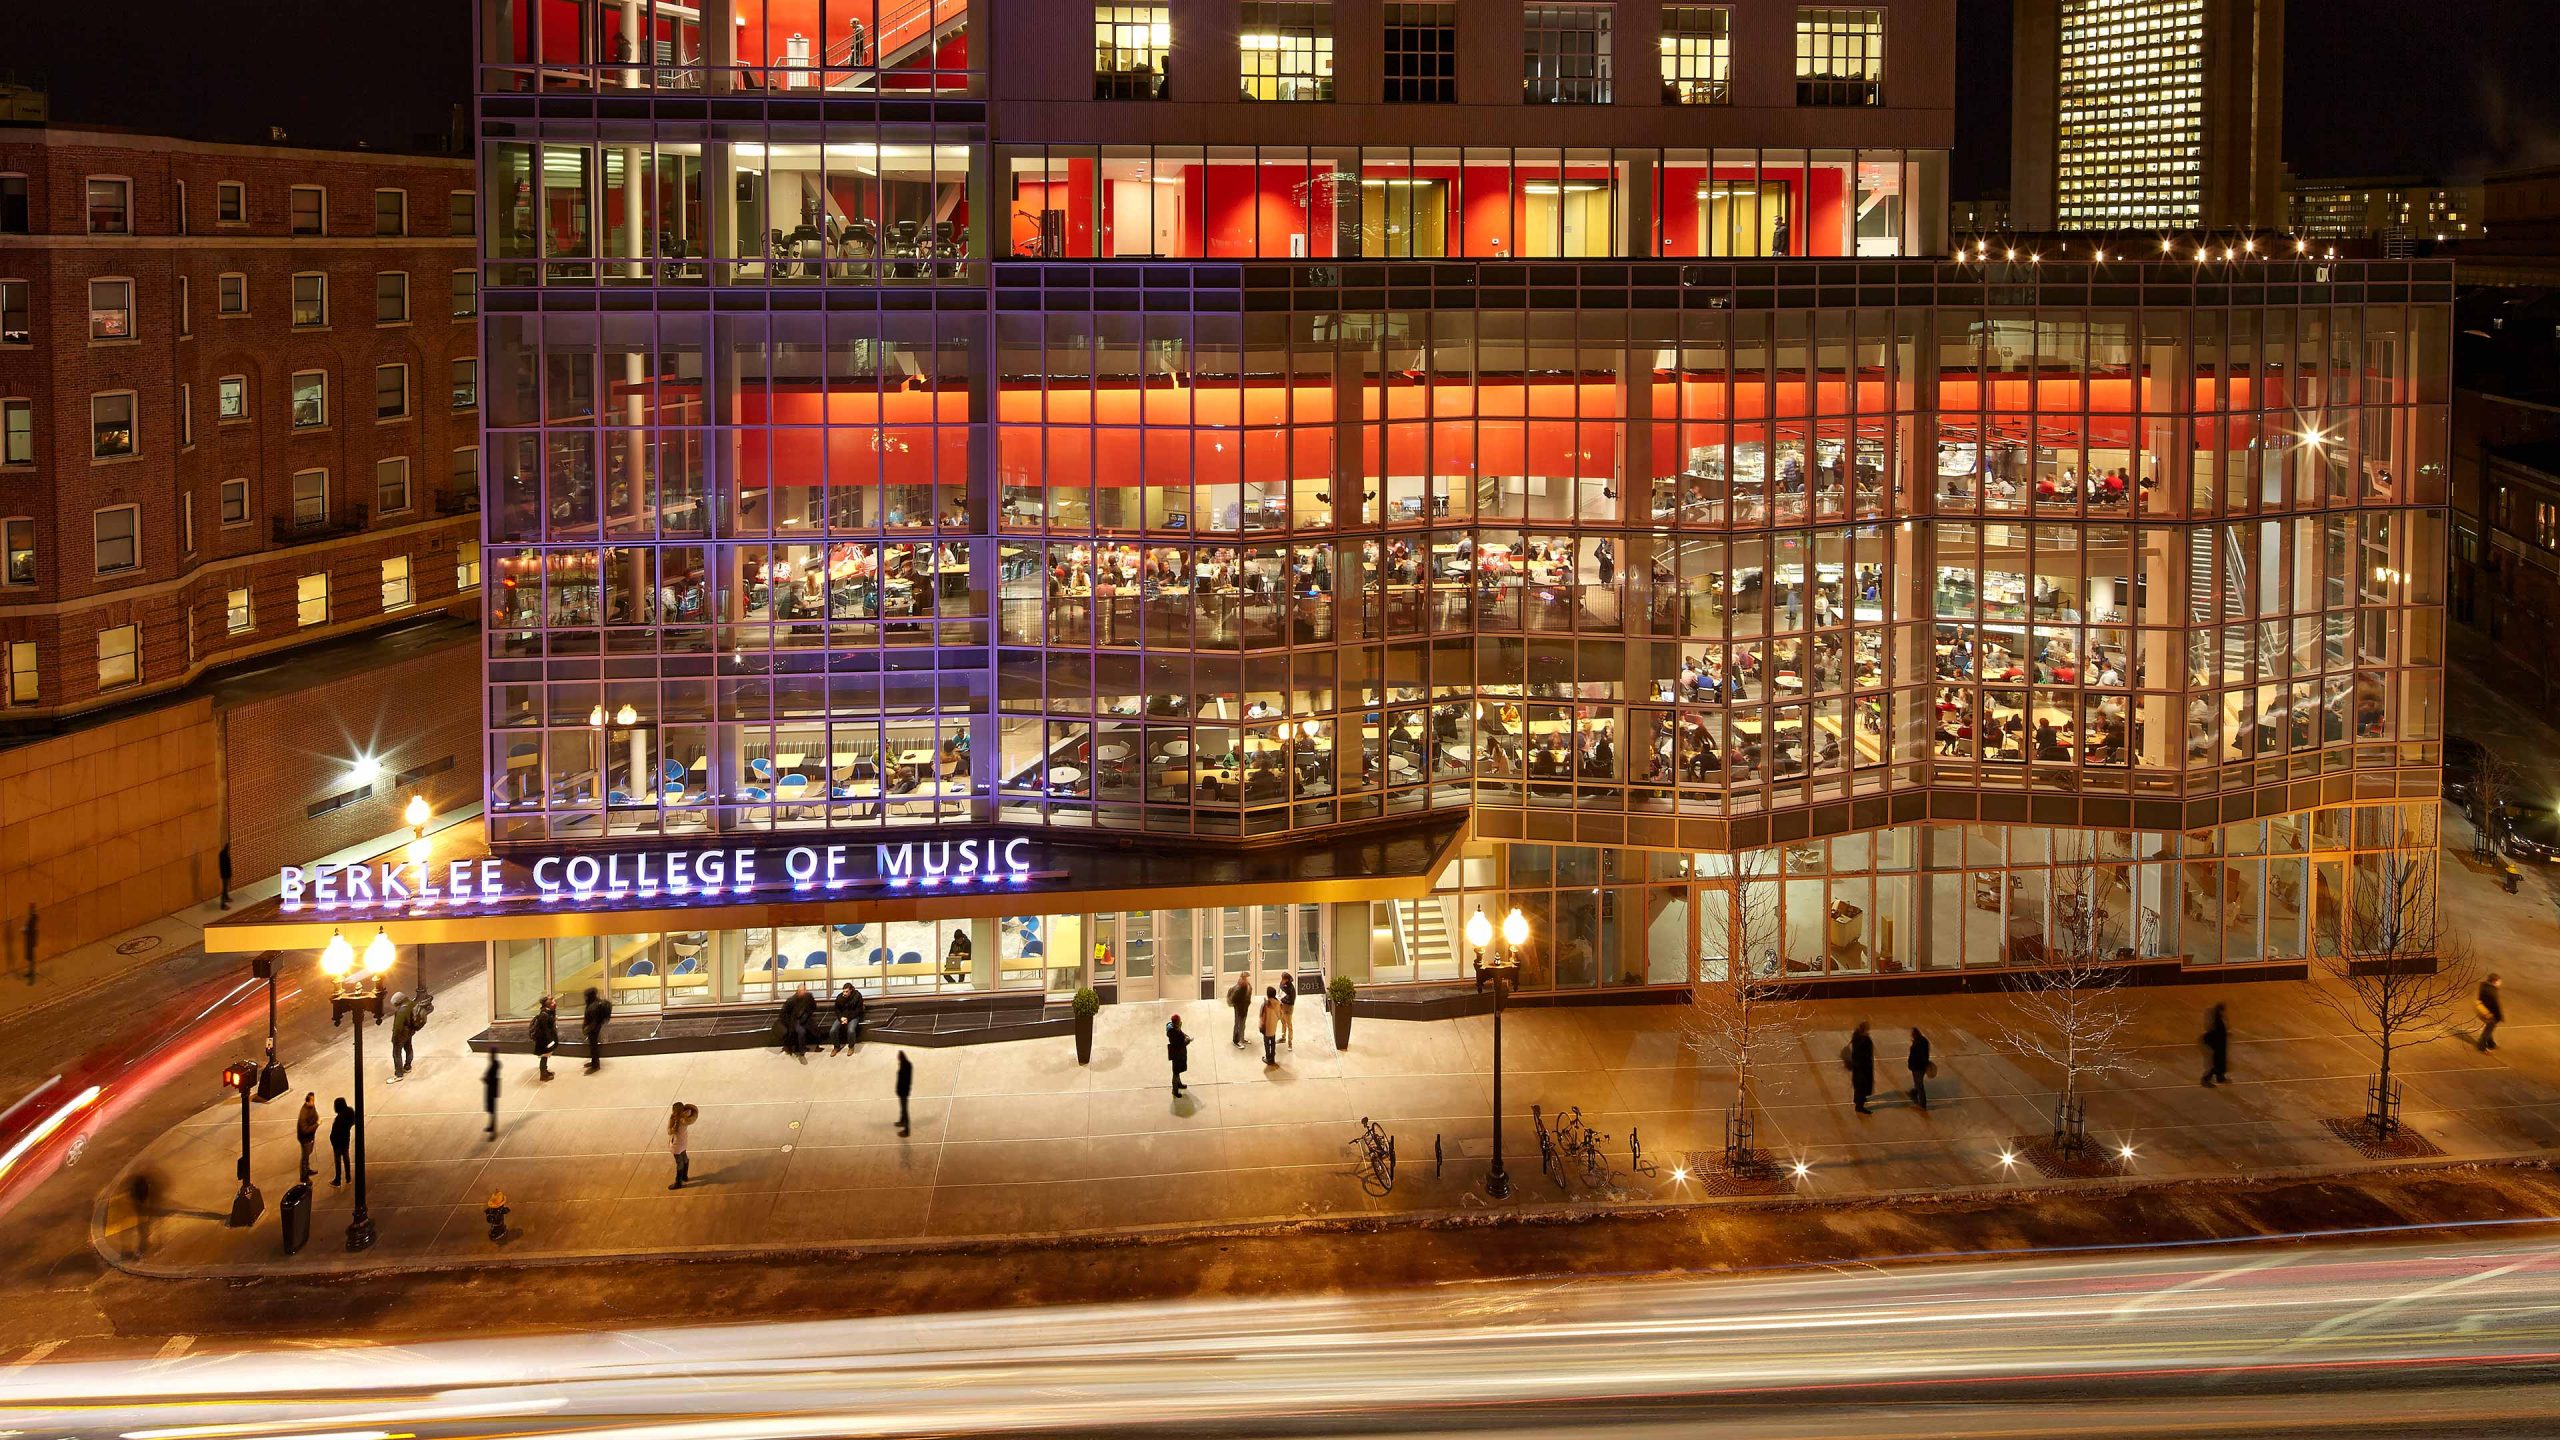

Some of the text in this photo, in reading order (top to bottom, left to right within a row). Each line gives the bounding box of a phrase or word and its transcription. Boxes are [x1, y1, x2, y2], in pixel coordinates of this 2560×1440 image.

[280, 838, 1030, 898] BERKLEE COLLEGE OF MUSIC
[1301, 982, 1320, 991] 2013
